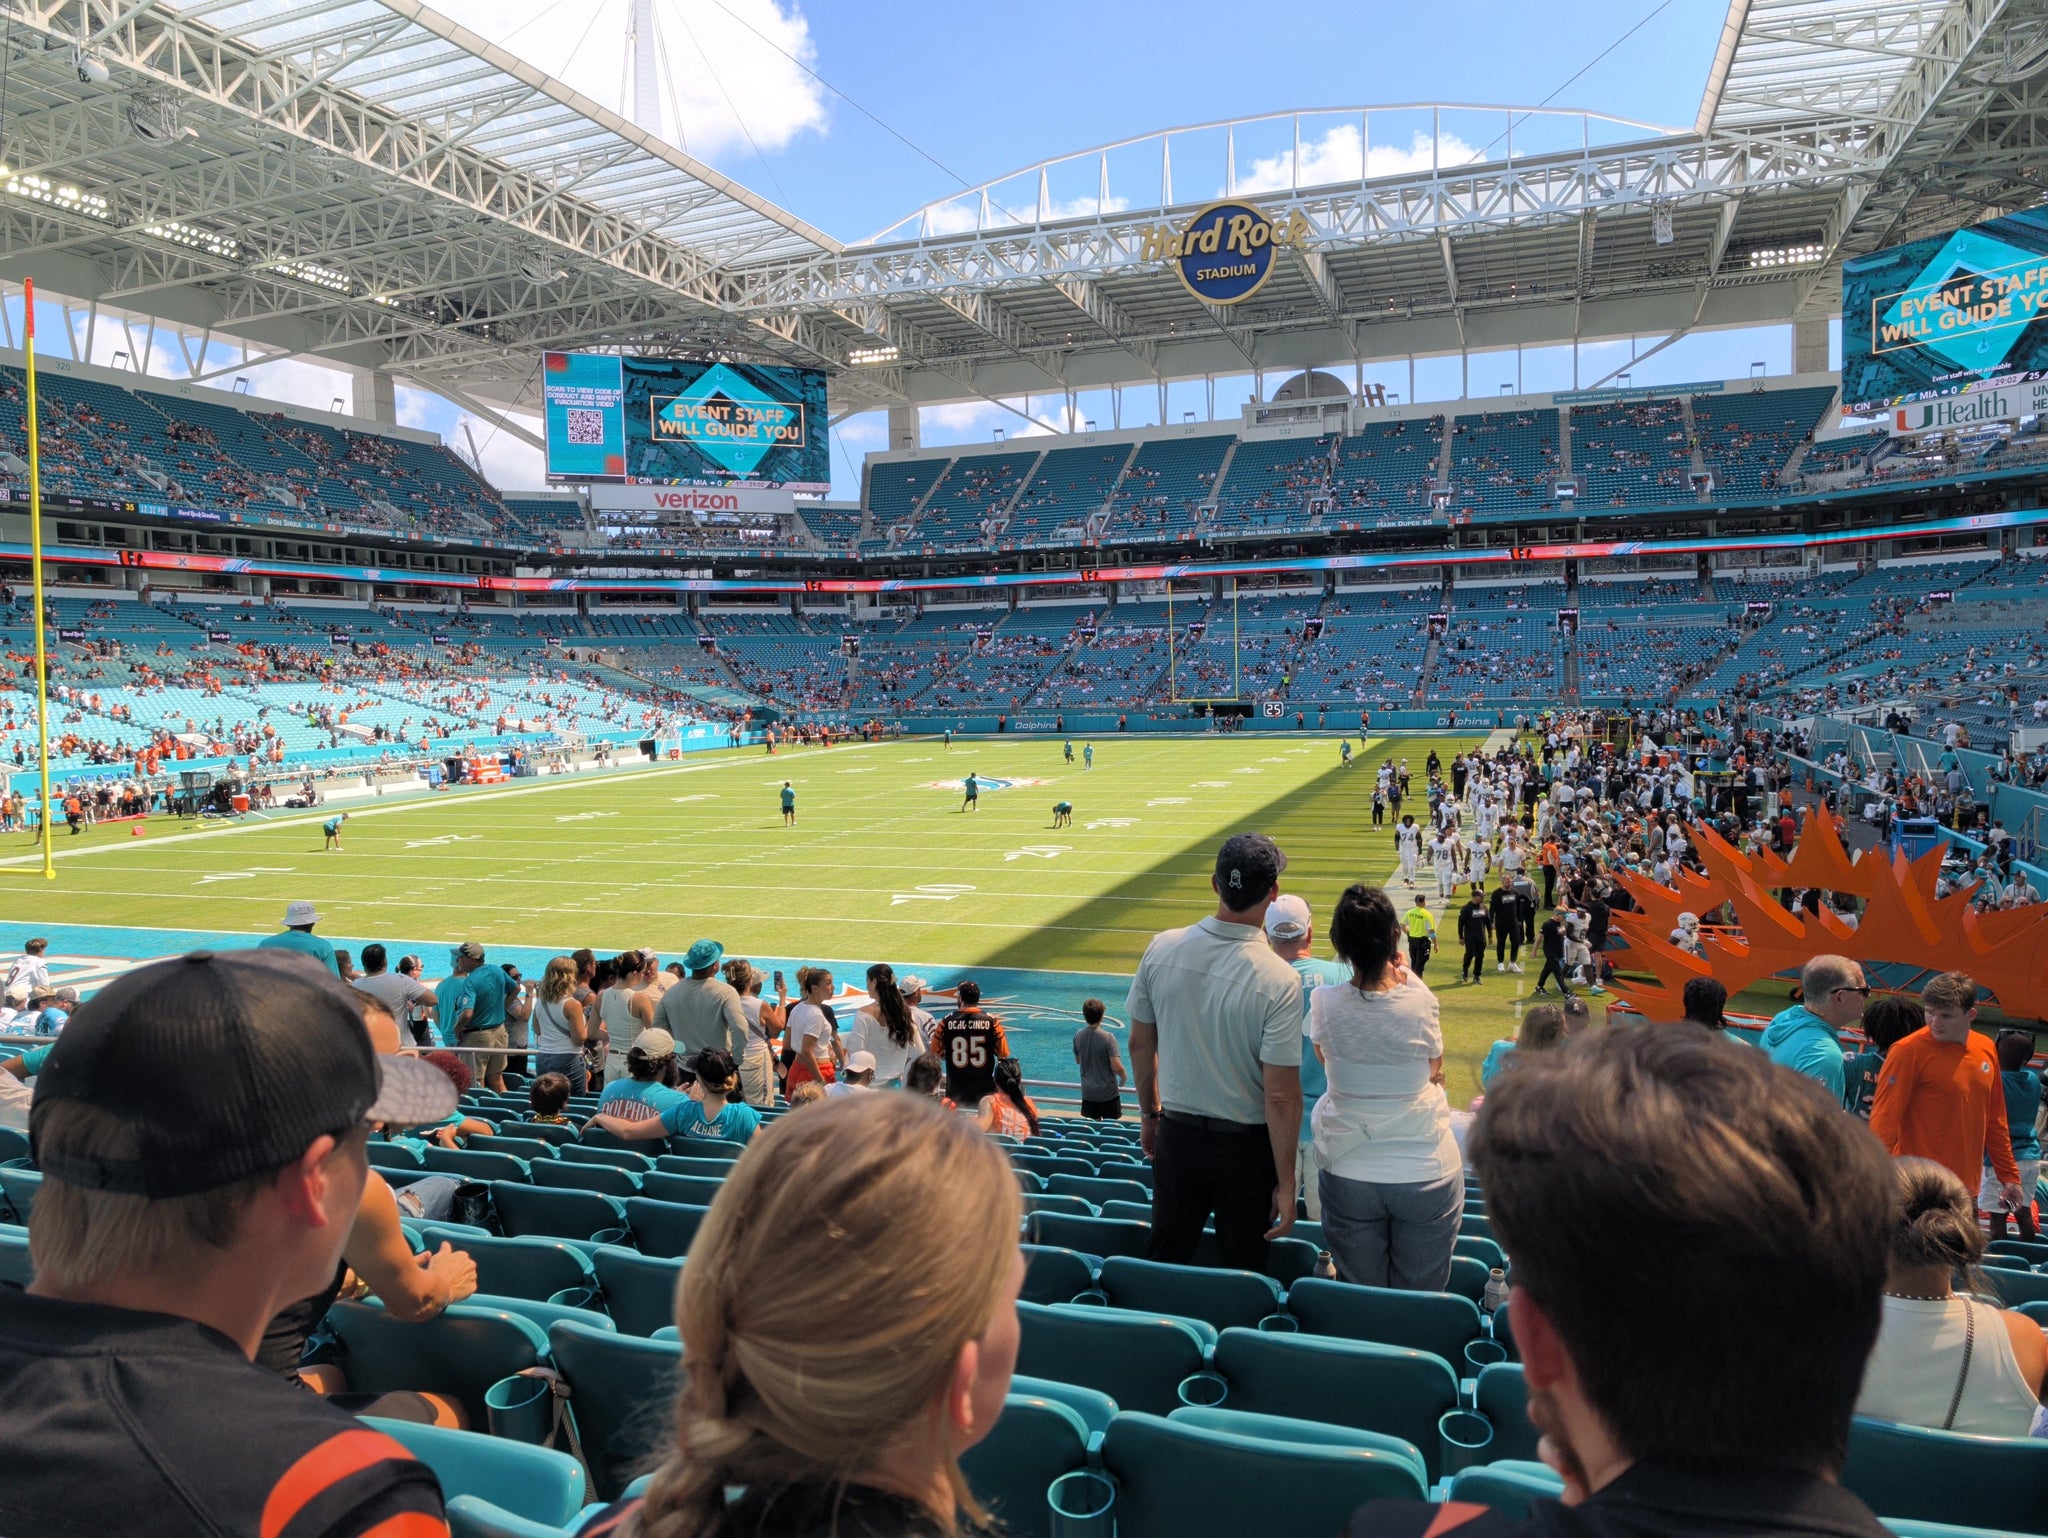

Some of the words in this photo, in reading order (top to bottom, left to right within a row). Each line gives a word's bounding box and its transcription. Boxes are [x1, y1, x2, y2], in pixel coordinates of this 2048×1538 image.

[1141, 216, 1225, 261] Hard
[1226, 208, 1308, 257] Rock
[1197, 263, 1257, 281] STADIUM
[1901, 284, 1974, 318] EVENT
[1881, 317, 1932, 342] WILL
[1939, 299, 2012, 330] GUIDE
[2019, 289, 2048, 311] YO
[56, 362, 70, 372] 320
[1932, 374, 1949, 383] Event
[1949, 370, 1964, 380] staff
[1984, 362, 2012, 374] available
[179, 386, 191, 394] 321
[1854, 402, 1871, 412] CIN
[1883, 399, 1890, 407] 0
[1920, 391, 1938, 400] MIA
[1951, 387, 1957, 395] 0
[1995, 376, 2018, 386] 29:02
[2029, 372, 2040, 380] 25
[285, 407, 296, 415] 322
[674, 404, 731, 420] EVENT
[735, 408, 784, 423] STAFF
[1933, 391, 2008, 426] Health
[659, 420, 700, 435] WILL
[705, 423, 758, 438] GUIDE
[763, 426, 799, 440] YOU
[1976, 432, 1998, 443] LIGHT
[125, 503, 135, 511] 35
[654, 489, 738, 510] verizon
[1266, 704, 1281, 715] 25
[1015, 721, 1058, 731] Dolphins
[1402, 833, 1414, 842] 74
[1003, 845, 1074, 861] 20
[1436, 850, 1448, 860] 78
[890, 884, 977, 906] 10
[968, 1020, 990, 1030] CINCO
[951, 1035, 987, 1069] 85
